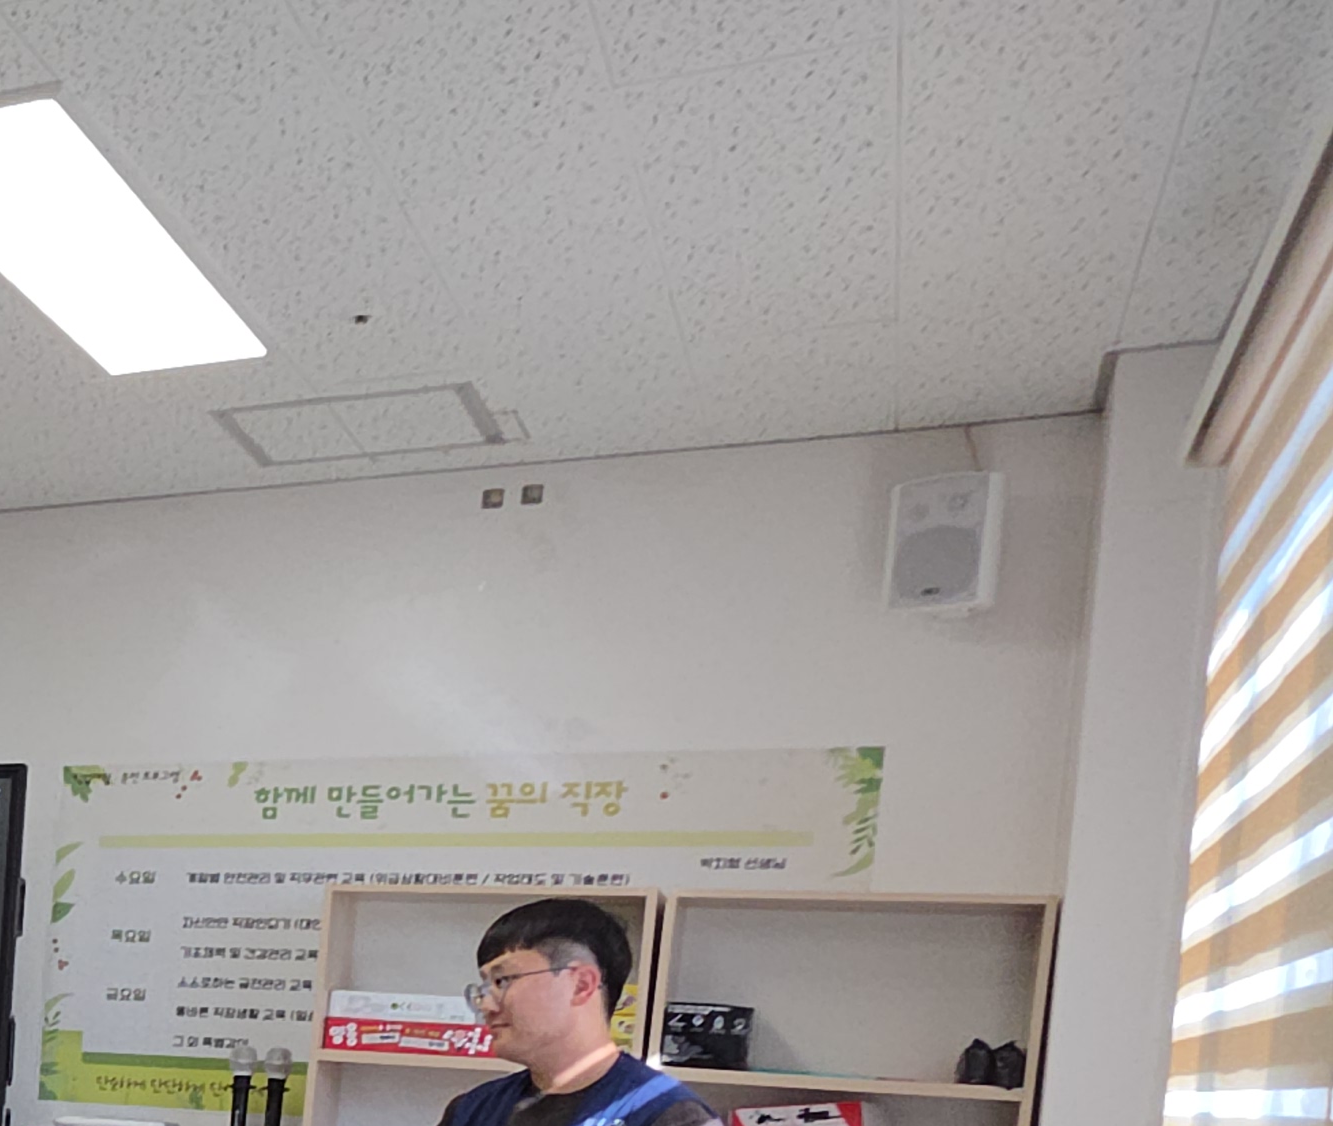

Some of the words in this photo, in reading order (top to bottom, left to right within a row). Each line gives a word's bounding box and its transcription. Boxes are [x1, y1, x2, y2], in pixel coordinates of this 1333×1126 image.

[254, 785, 316, 820] 함께
[327, 784, 477, 821] 만들어가는
[486, 781, 548, 819] 꿈의
[559, 780, 627, 818] 직장
[115, 870, 157, 885] 수요일
[274, 872, 286, 885] 및
[342, 872, 365, 885] 교육
[550, 873, 566, 886] 및
[110, 928, 152, 944] 목요일
[229, 946, 242, 960] 및
[295, 948, 320, 962] 교육
[289, 978, 313, 992] 교육
[105, 987, 148, 1003] 금요일
[262, 1008, 287, 1022] 교육
[172, 1034, 184, 1048] 그
